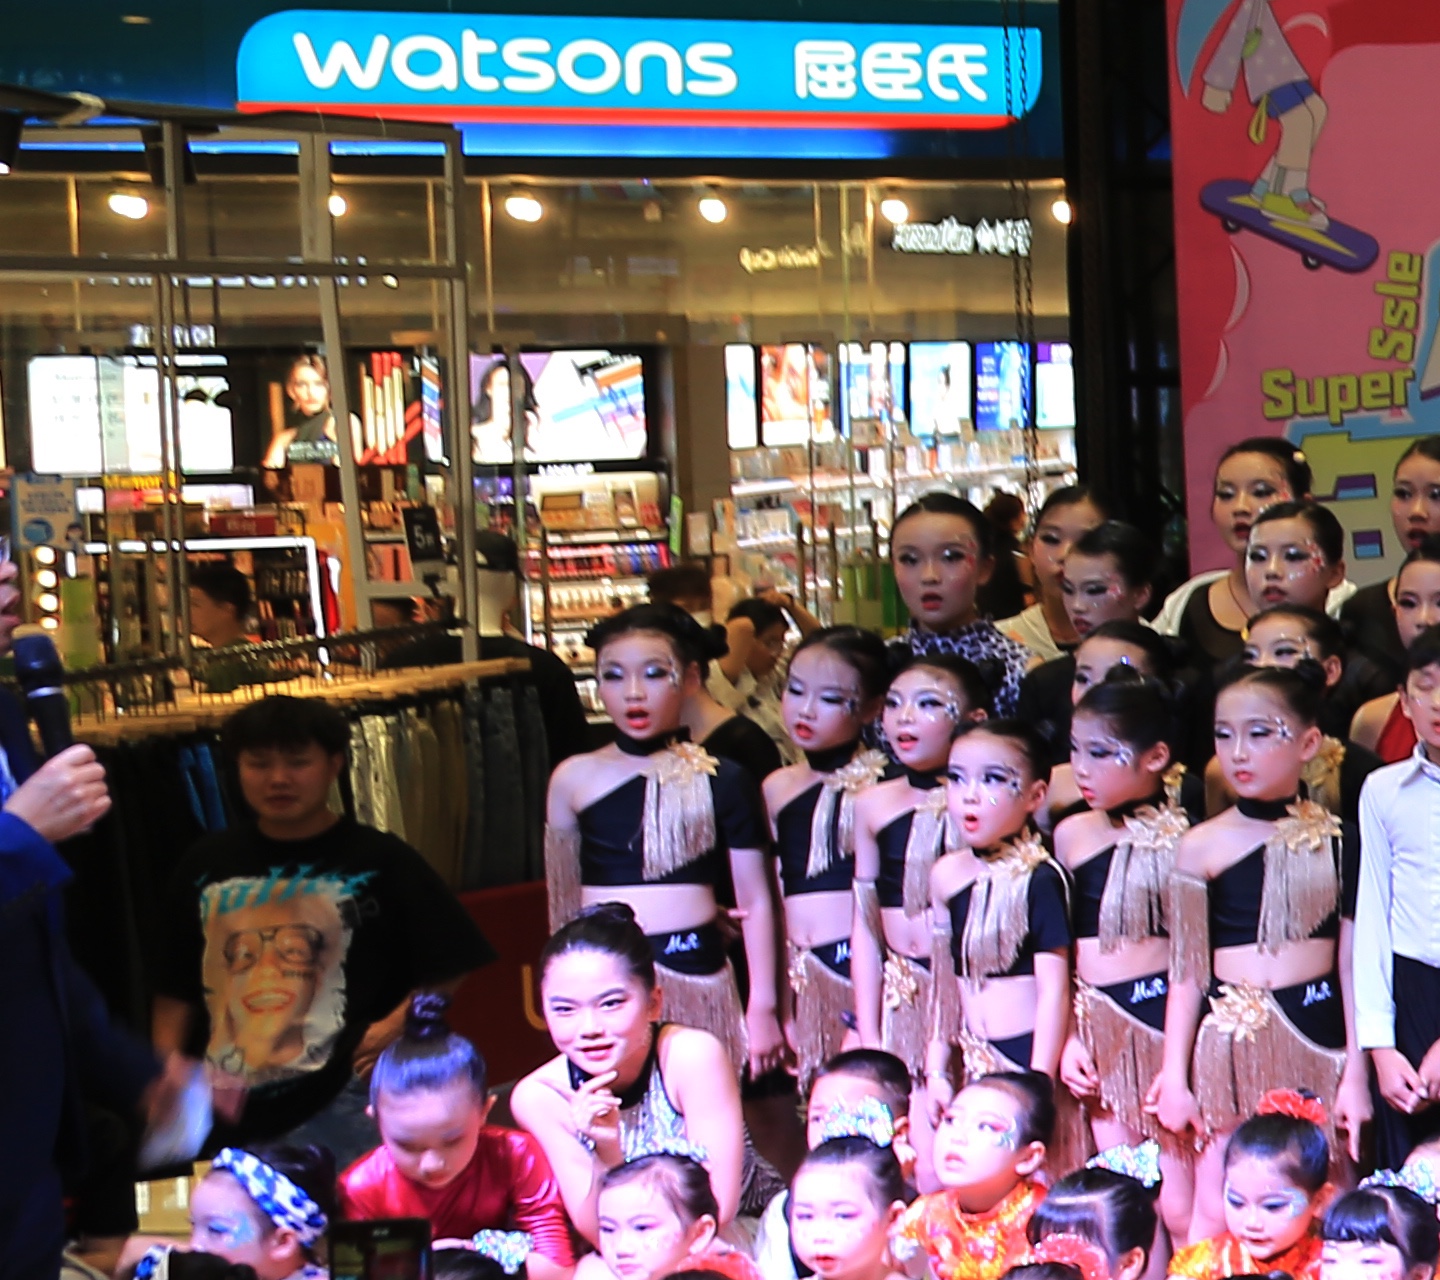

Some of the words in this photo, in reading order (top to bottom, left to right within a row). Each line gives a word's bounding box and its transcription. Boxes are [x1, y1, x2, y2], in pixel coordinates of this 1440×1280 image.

[292, 28, 738, 97] watsons
[794, 39, 989, 102] 屈臣氏
[1370, 254, 1422, 362] Ssle
[1262, 365, 1416, 425] Super
